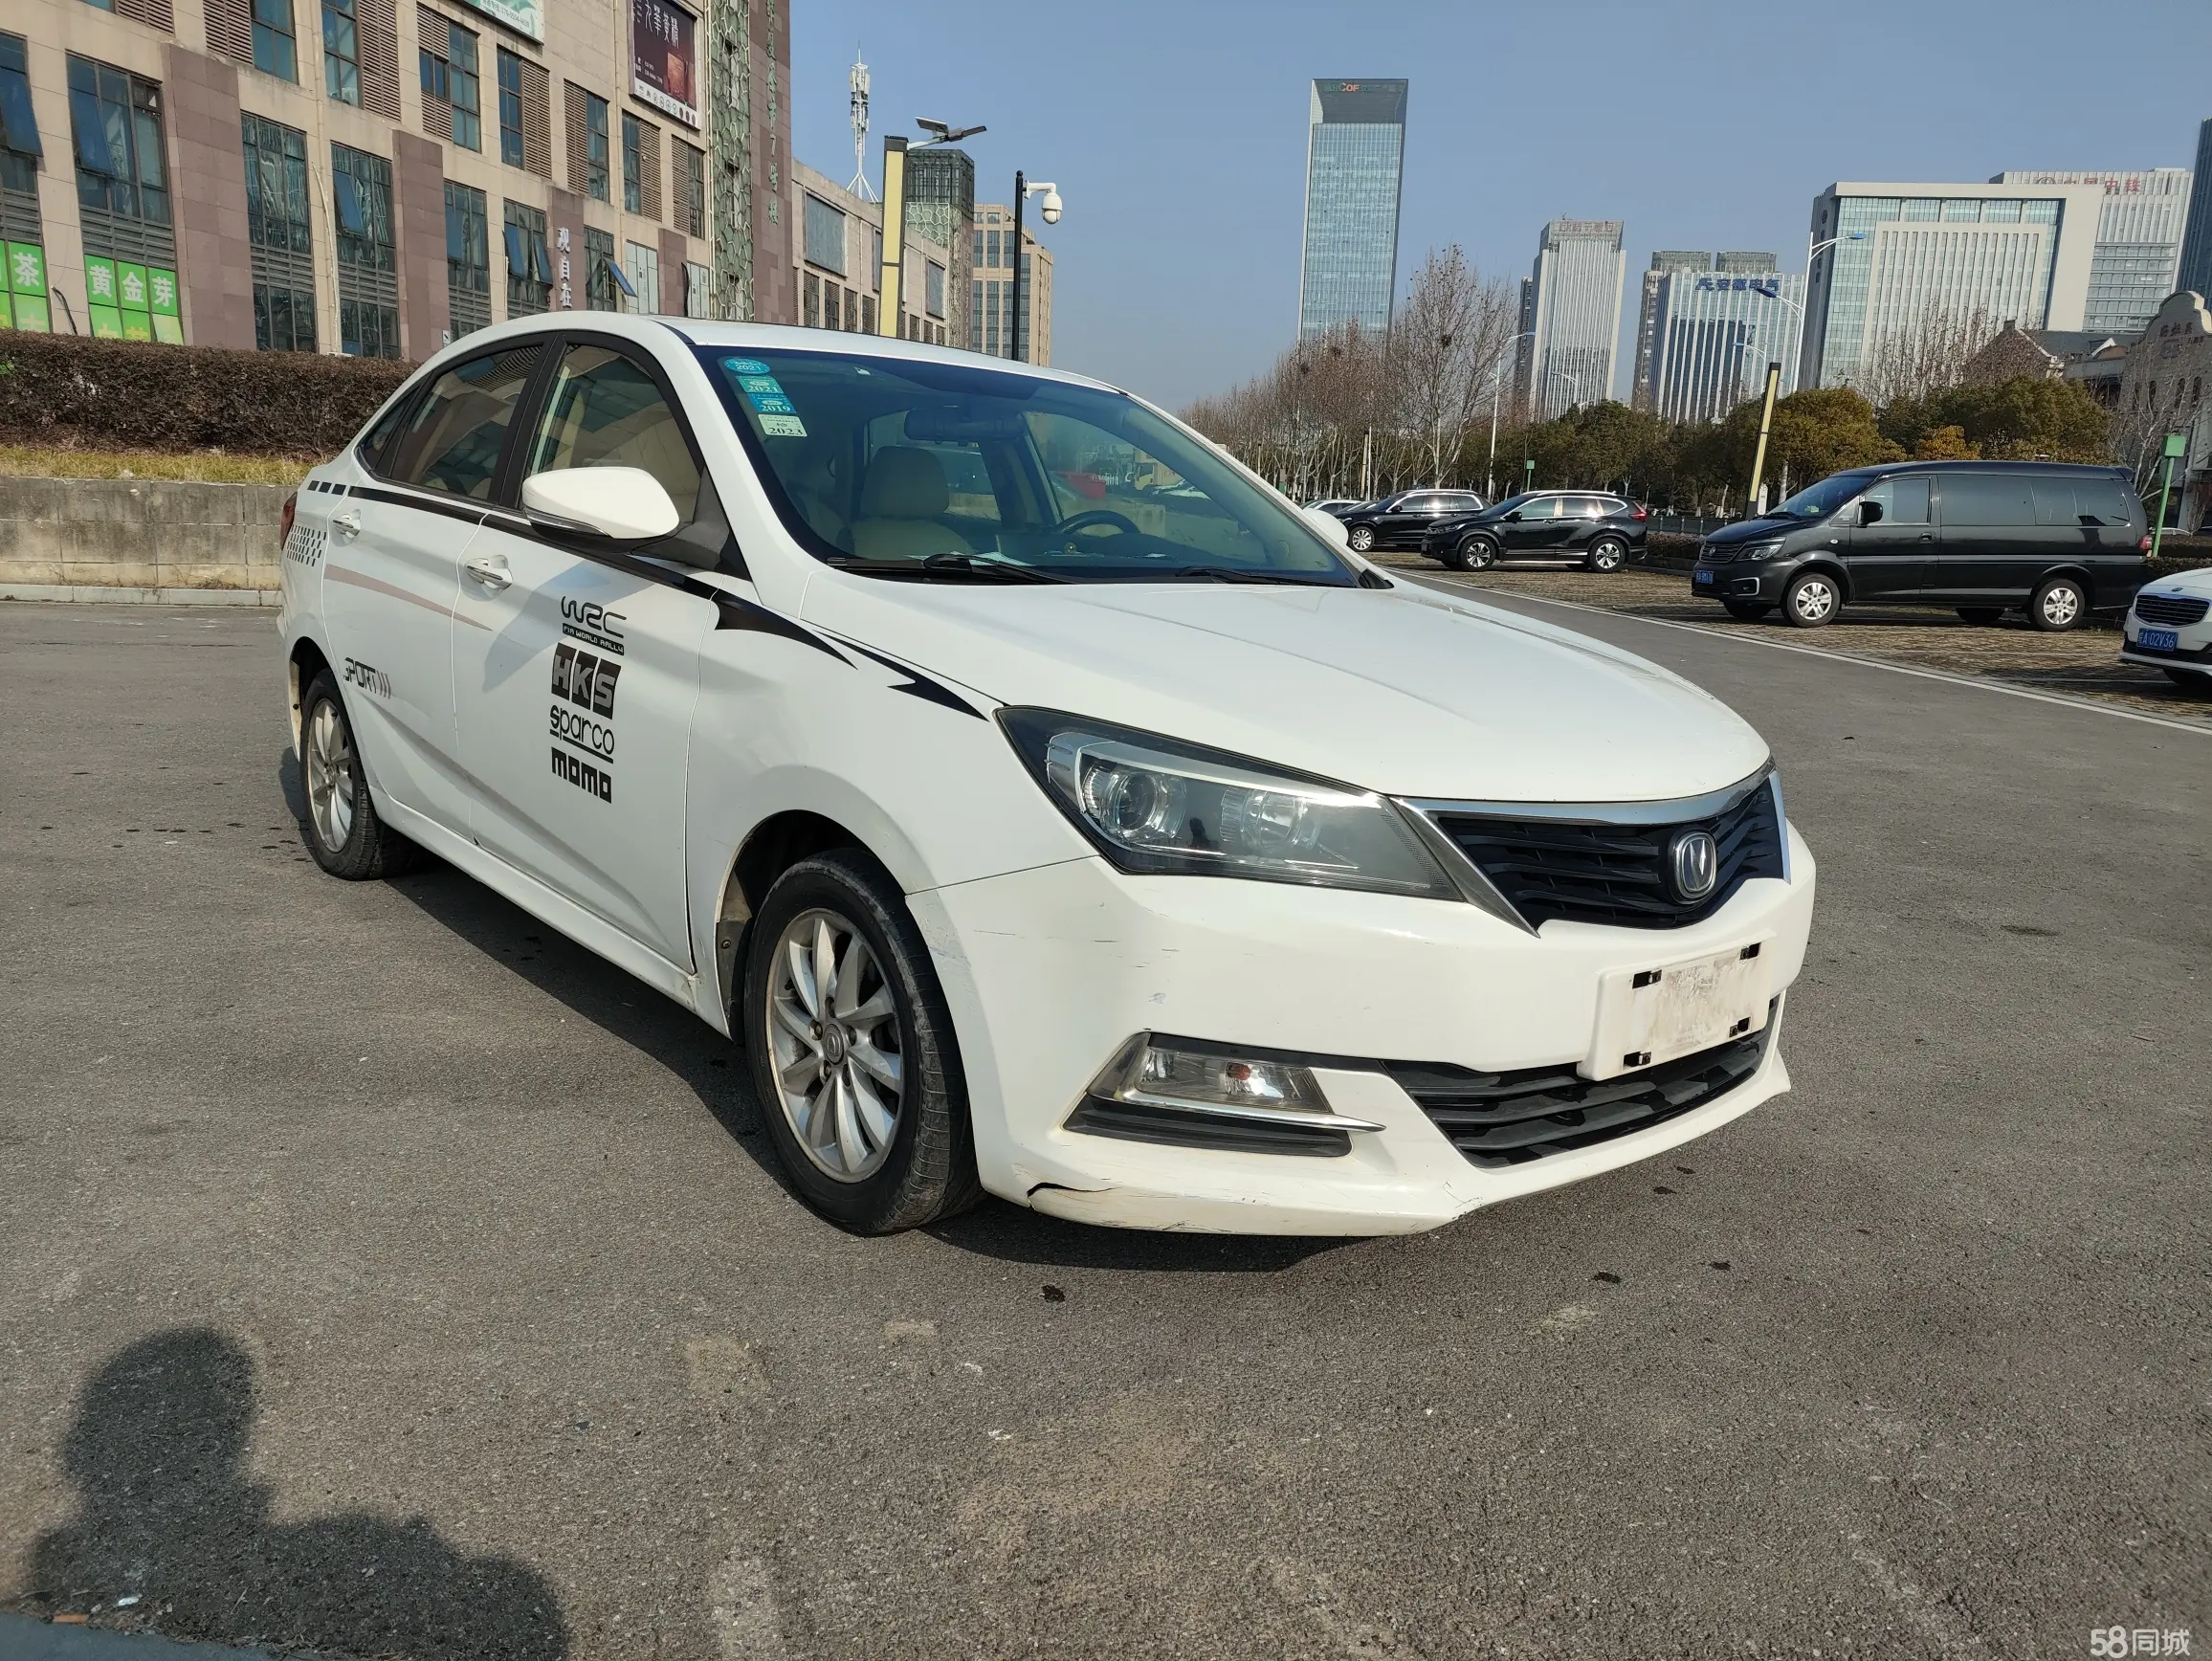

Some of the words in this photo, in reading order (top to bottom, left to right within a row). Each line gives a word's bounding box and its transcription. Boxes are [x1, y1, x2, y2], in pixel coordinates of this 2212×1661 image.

[88, 264, 174, 307] 黄金芽
[558, 227, 572, 308] 观自在
[768, 427, 804, 435] 2023
[561, 595, 628, 639] WRC
[575, 630, 598, 644] WORLD
[600, 639, 624, 653] RALLY
[552, 653, 617, 709] HKS
[550, 704, 615, 755] sparco
[551, 746, 612, 805] momo
